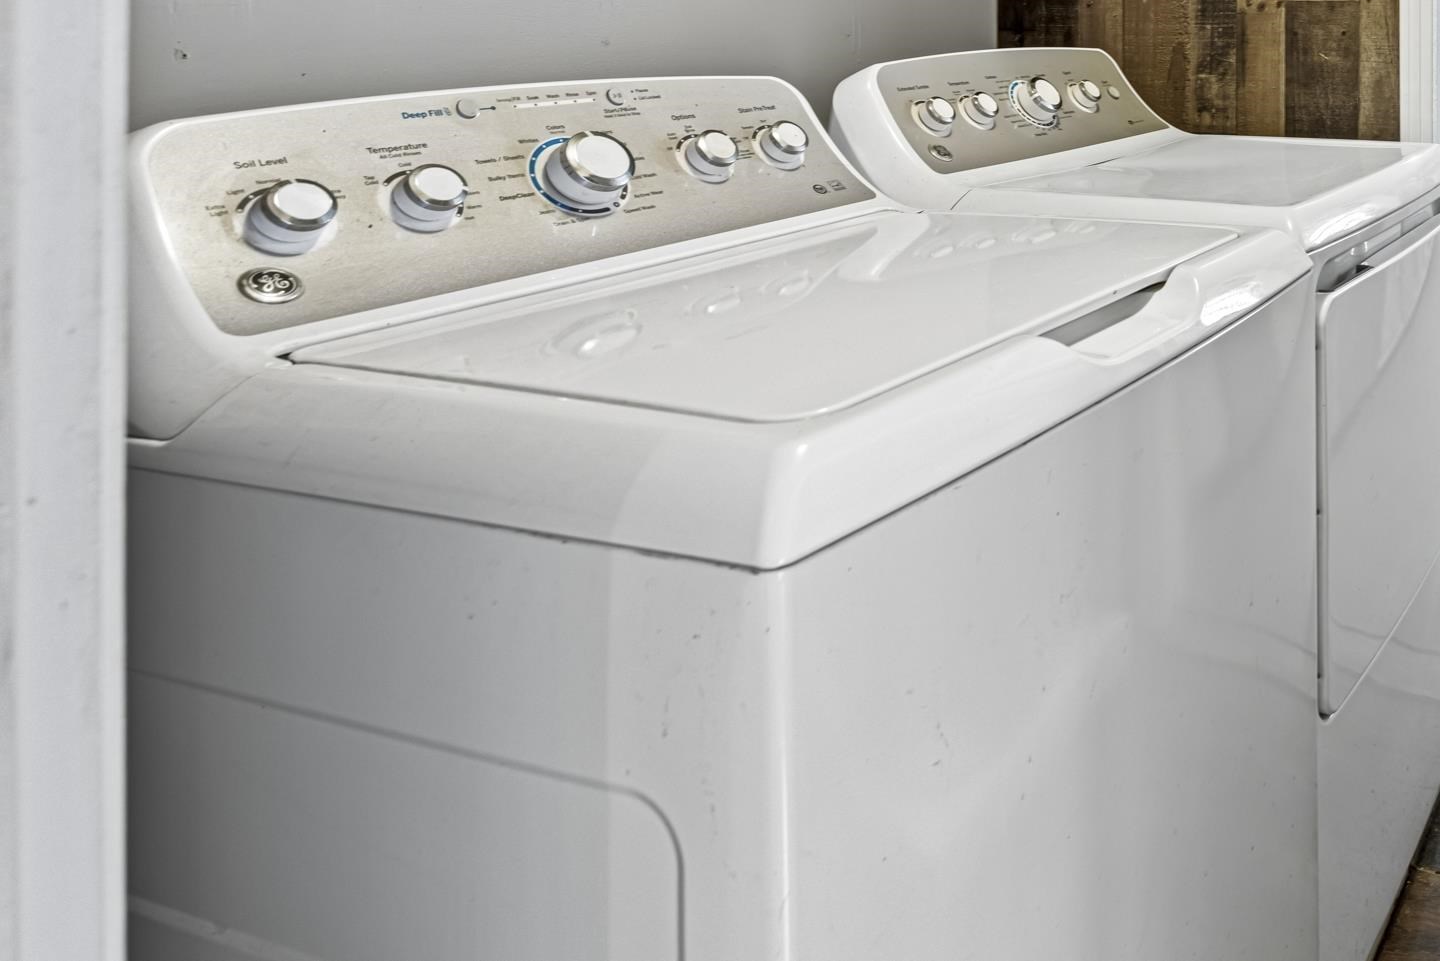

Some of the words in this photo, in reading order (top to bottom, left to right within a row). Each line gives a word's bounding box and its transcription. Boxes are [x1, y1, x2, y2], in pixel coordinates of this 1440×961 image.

[401, 111, 427, 120] Deep
[428, 109, 443, 117] Fill
[366, 142, 428, 154] Temperature
[233, 160, 256, 169] Soil
[258, 156, 288, 166] Level
